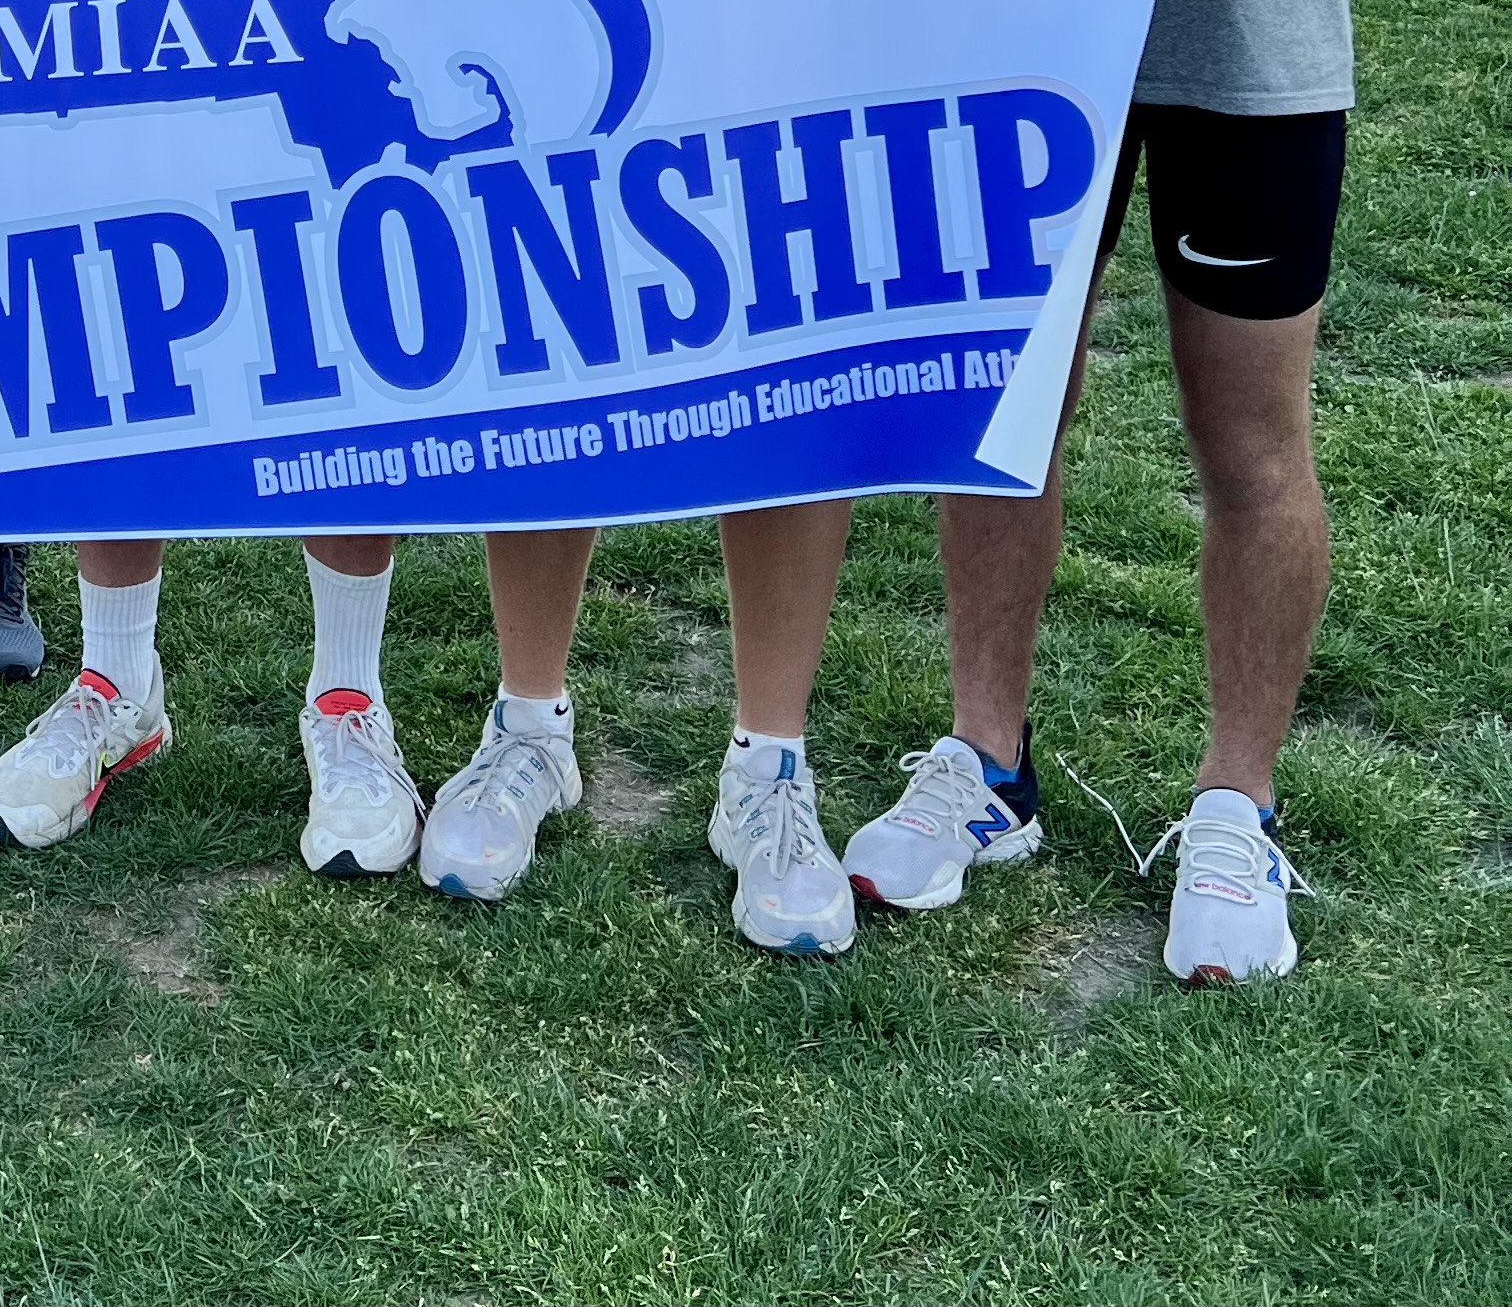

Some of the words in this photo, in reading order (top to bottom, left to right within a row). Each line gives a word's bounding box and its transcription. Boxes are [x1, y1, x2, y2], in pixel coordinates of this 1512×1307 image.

[252, 446, 407, 498] Building
[411, 436, 475, 478] the
[480, 422, 603, 471] Future
[607, 390, 752, 452] Through
[755, 352, 956, 423] Educational
